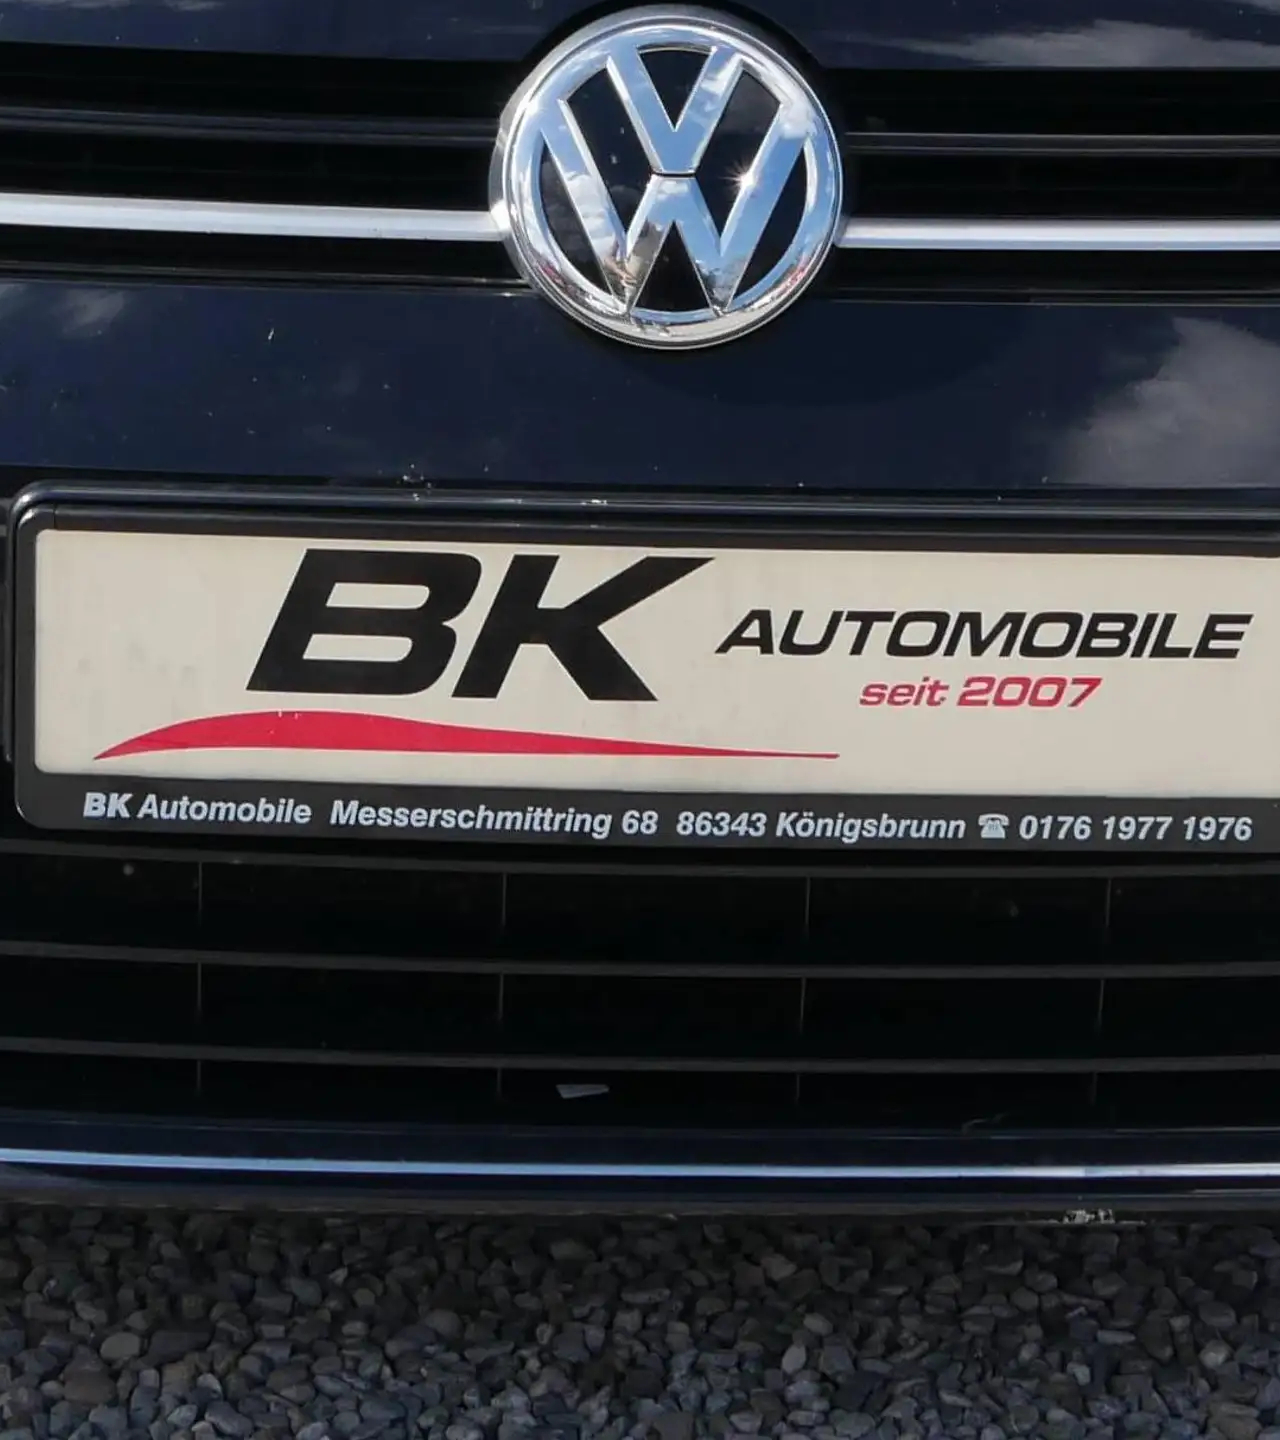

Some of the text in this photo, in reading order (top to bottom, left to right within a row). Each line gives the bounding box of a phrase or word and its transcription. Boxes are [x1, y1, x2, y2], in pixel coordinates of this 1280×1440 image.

[246, 548, 1254, 702] BK AUTOMOBILE
[859, 675, 1102, 708] seit 2007
[83, 792, 1254, 844] BK Automobile Messerschmittring 68 86343 Königsbrunn 0176 1977 1976
